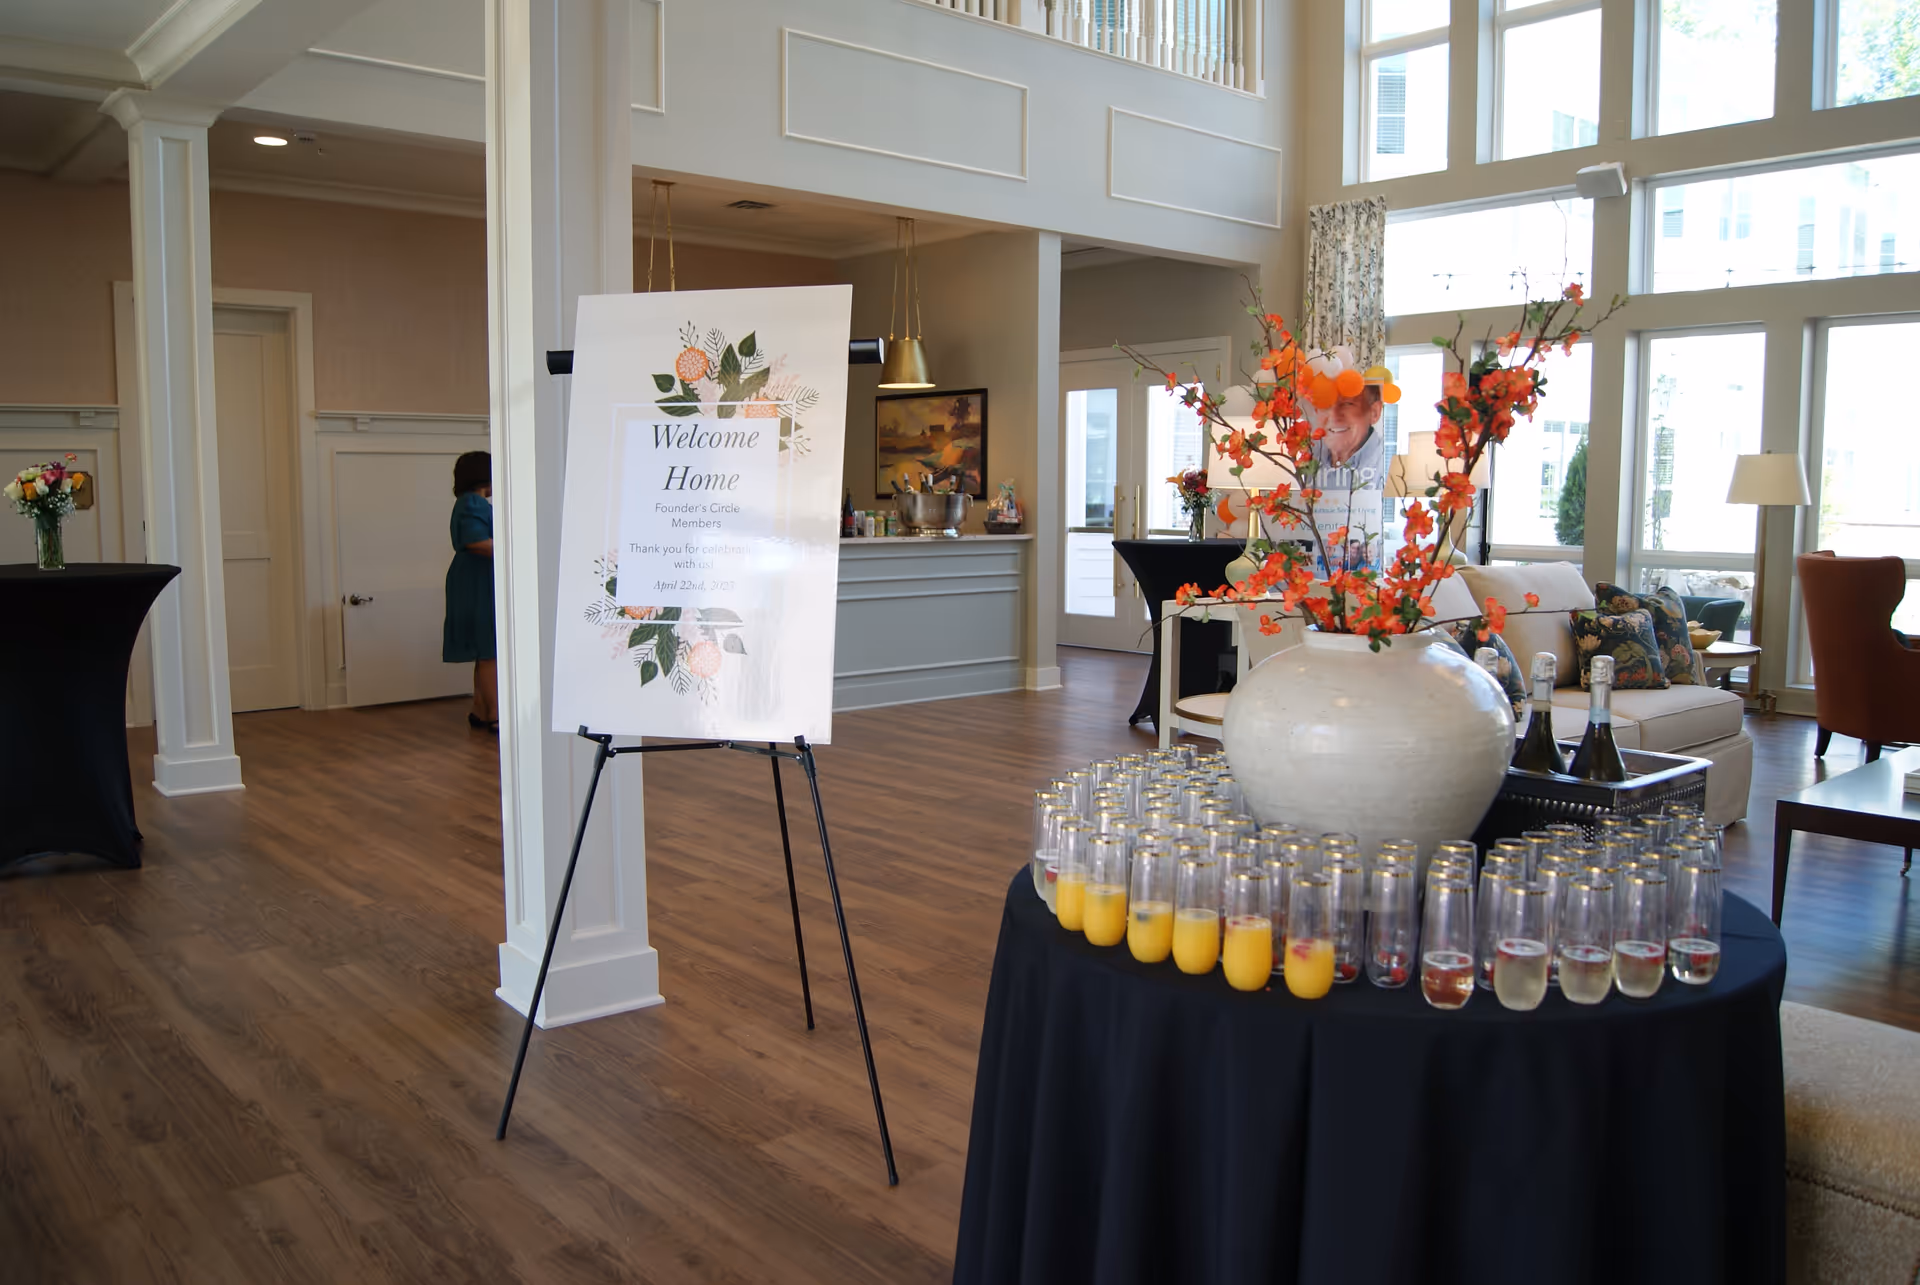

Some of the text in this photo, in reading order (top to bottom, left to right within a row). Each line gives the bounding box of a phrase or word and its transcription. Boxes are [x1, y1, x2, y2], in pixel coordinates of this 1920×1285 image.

[652, 424, 759, 449] Welcome
[661, 466, 740, 491] Home
[655, 502, 740, 513] Founder's Circle
[671, 518, 722, 529] Members
[629, 543, 660, 554] Thank
[662, 545, 682, 556] you
[684, 543, 699, 554] for
[674, 558, 696, 569] with
[653, 580, 678, 592] April
[679, 580, 707, 591] 22nd,
